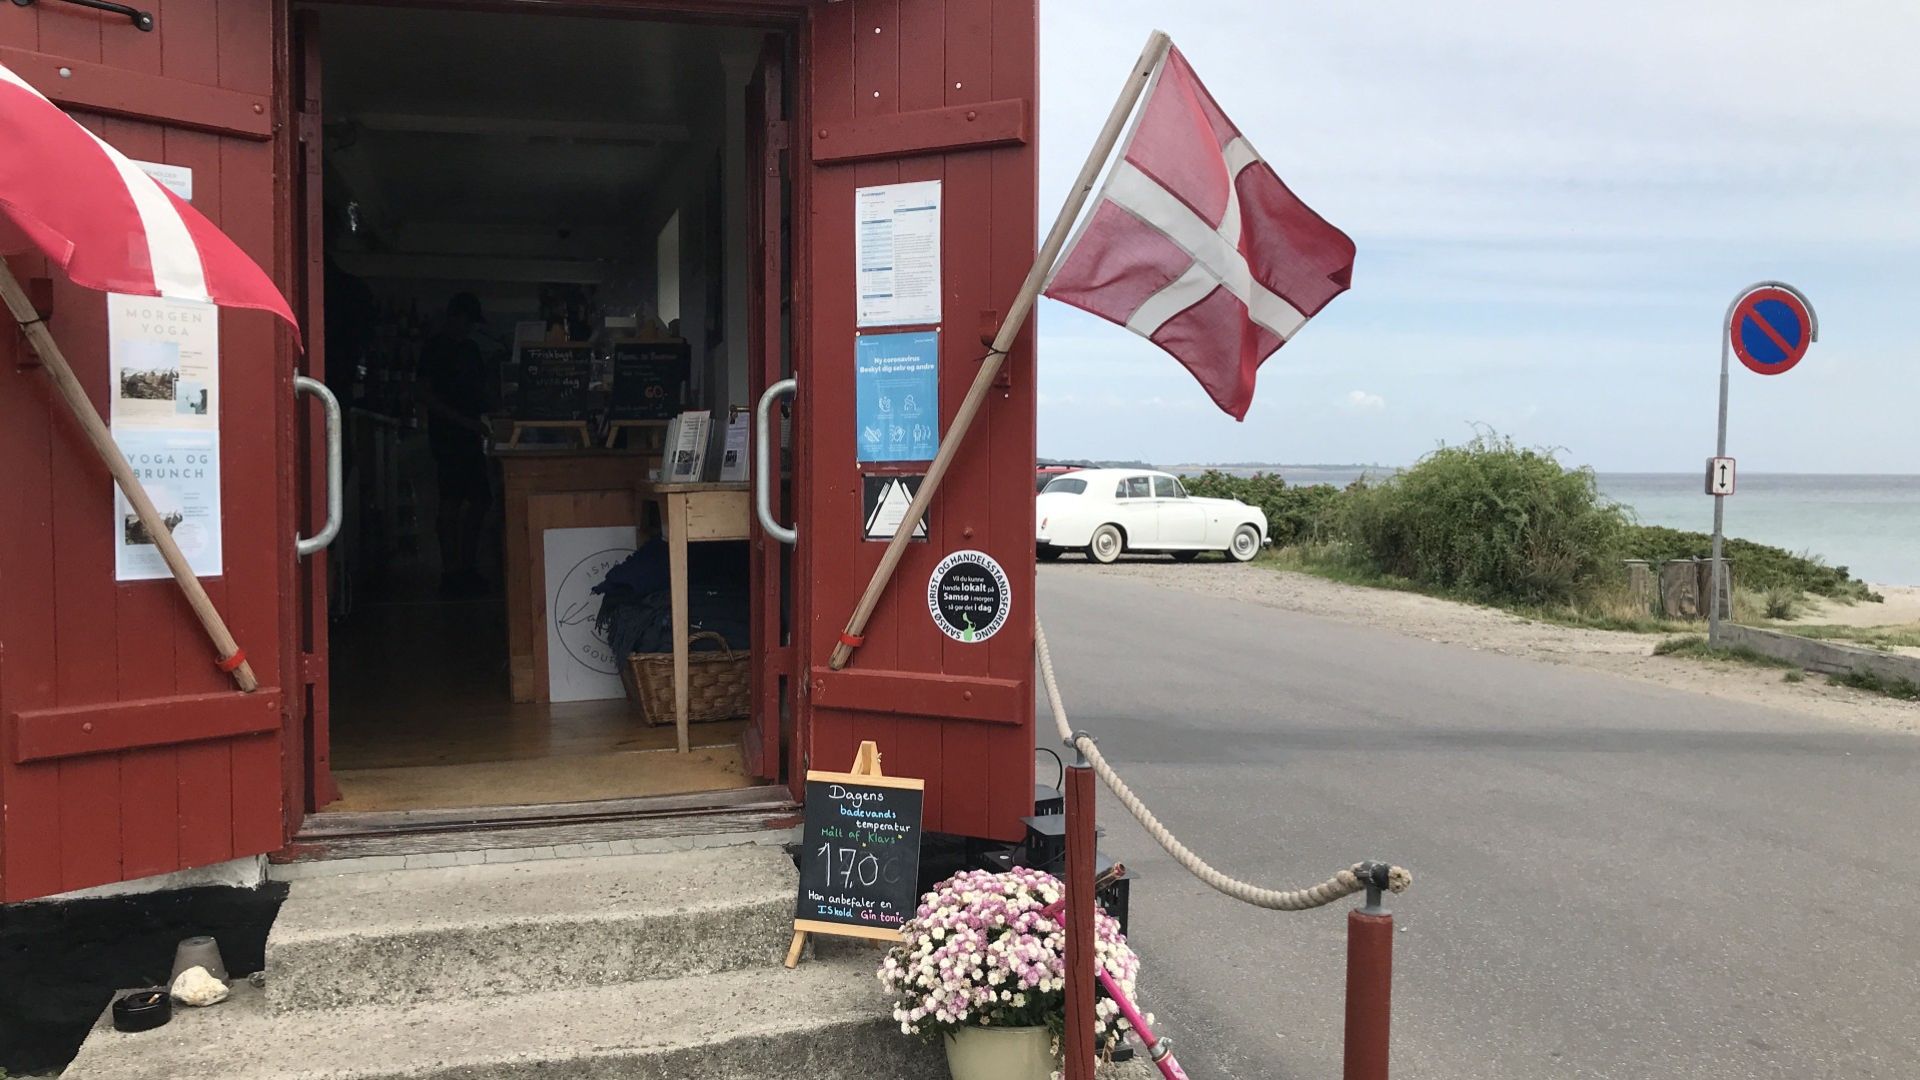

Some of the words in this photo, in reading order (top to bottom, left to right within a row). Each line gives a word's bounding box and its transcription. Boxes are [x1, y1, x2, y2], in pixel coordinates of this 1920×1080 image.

[126, 308, 201, 322] MORGEN
[142, 323, 189, 336] YOGA
[860, 366, 881, 374] Beskyt
[882, 365, 892, 373] dig
[127, 454, 175, 464] YOGA
[186, 454, 208, 464] OG
[133, 468, 204, 478] BRUNCH
[938, 562, 950, 575] OG
[961, 582, 986, 592] lokalt
[943, 592, 969, 601] Samsø
[950, 553, 1009, 640] HANDELSSTANDSFORENING
[978, 603, 992, 613] dag
[934, 613, 961, 640] SAMSØ
[828, 784, 884, 808] Dagens
[840, 804, 896, 819] badevands
[821, 825, 843, 838] Målt
[848, 830, 860, 841] af
[856, 820, 911, 833] temperatur
[808, 889, 825, 901] Han
[829, 893, 875, 908] anbefaler
[880, 901, 892, 909] en
[861, 909, 876, 920] Gin
[880, 911, 905, 923] tonic
